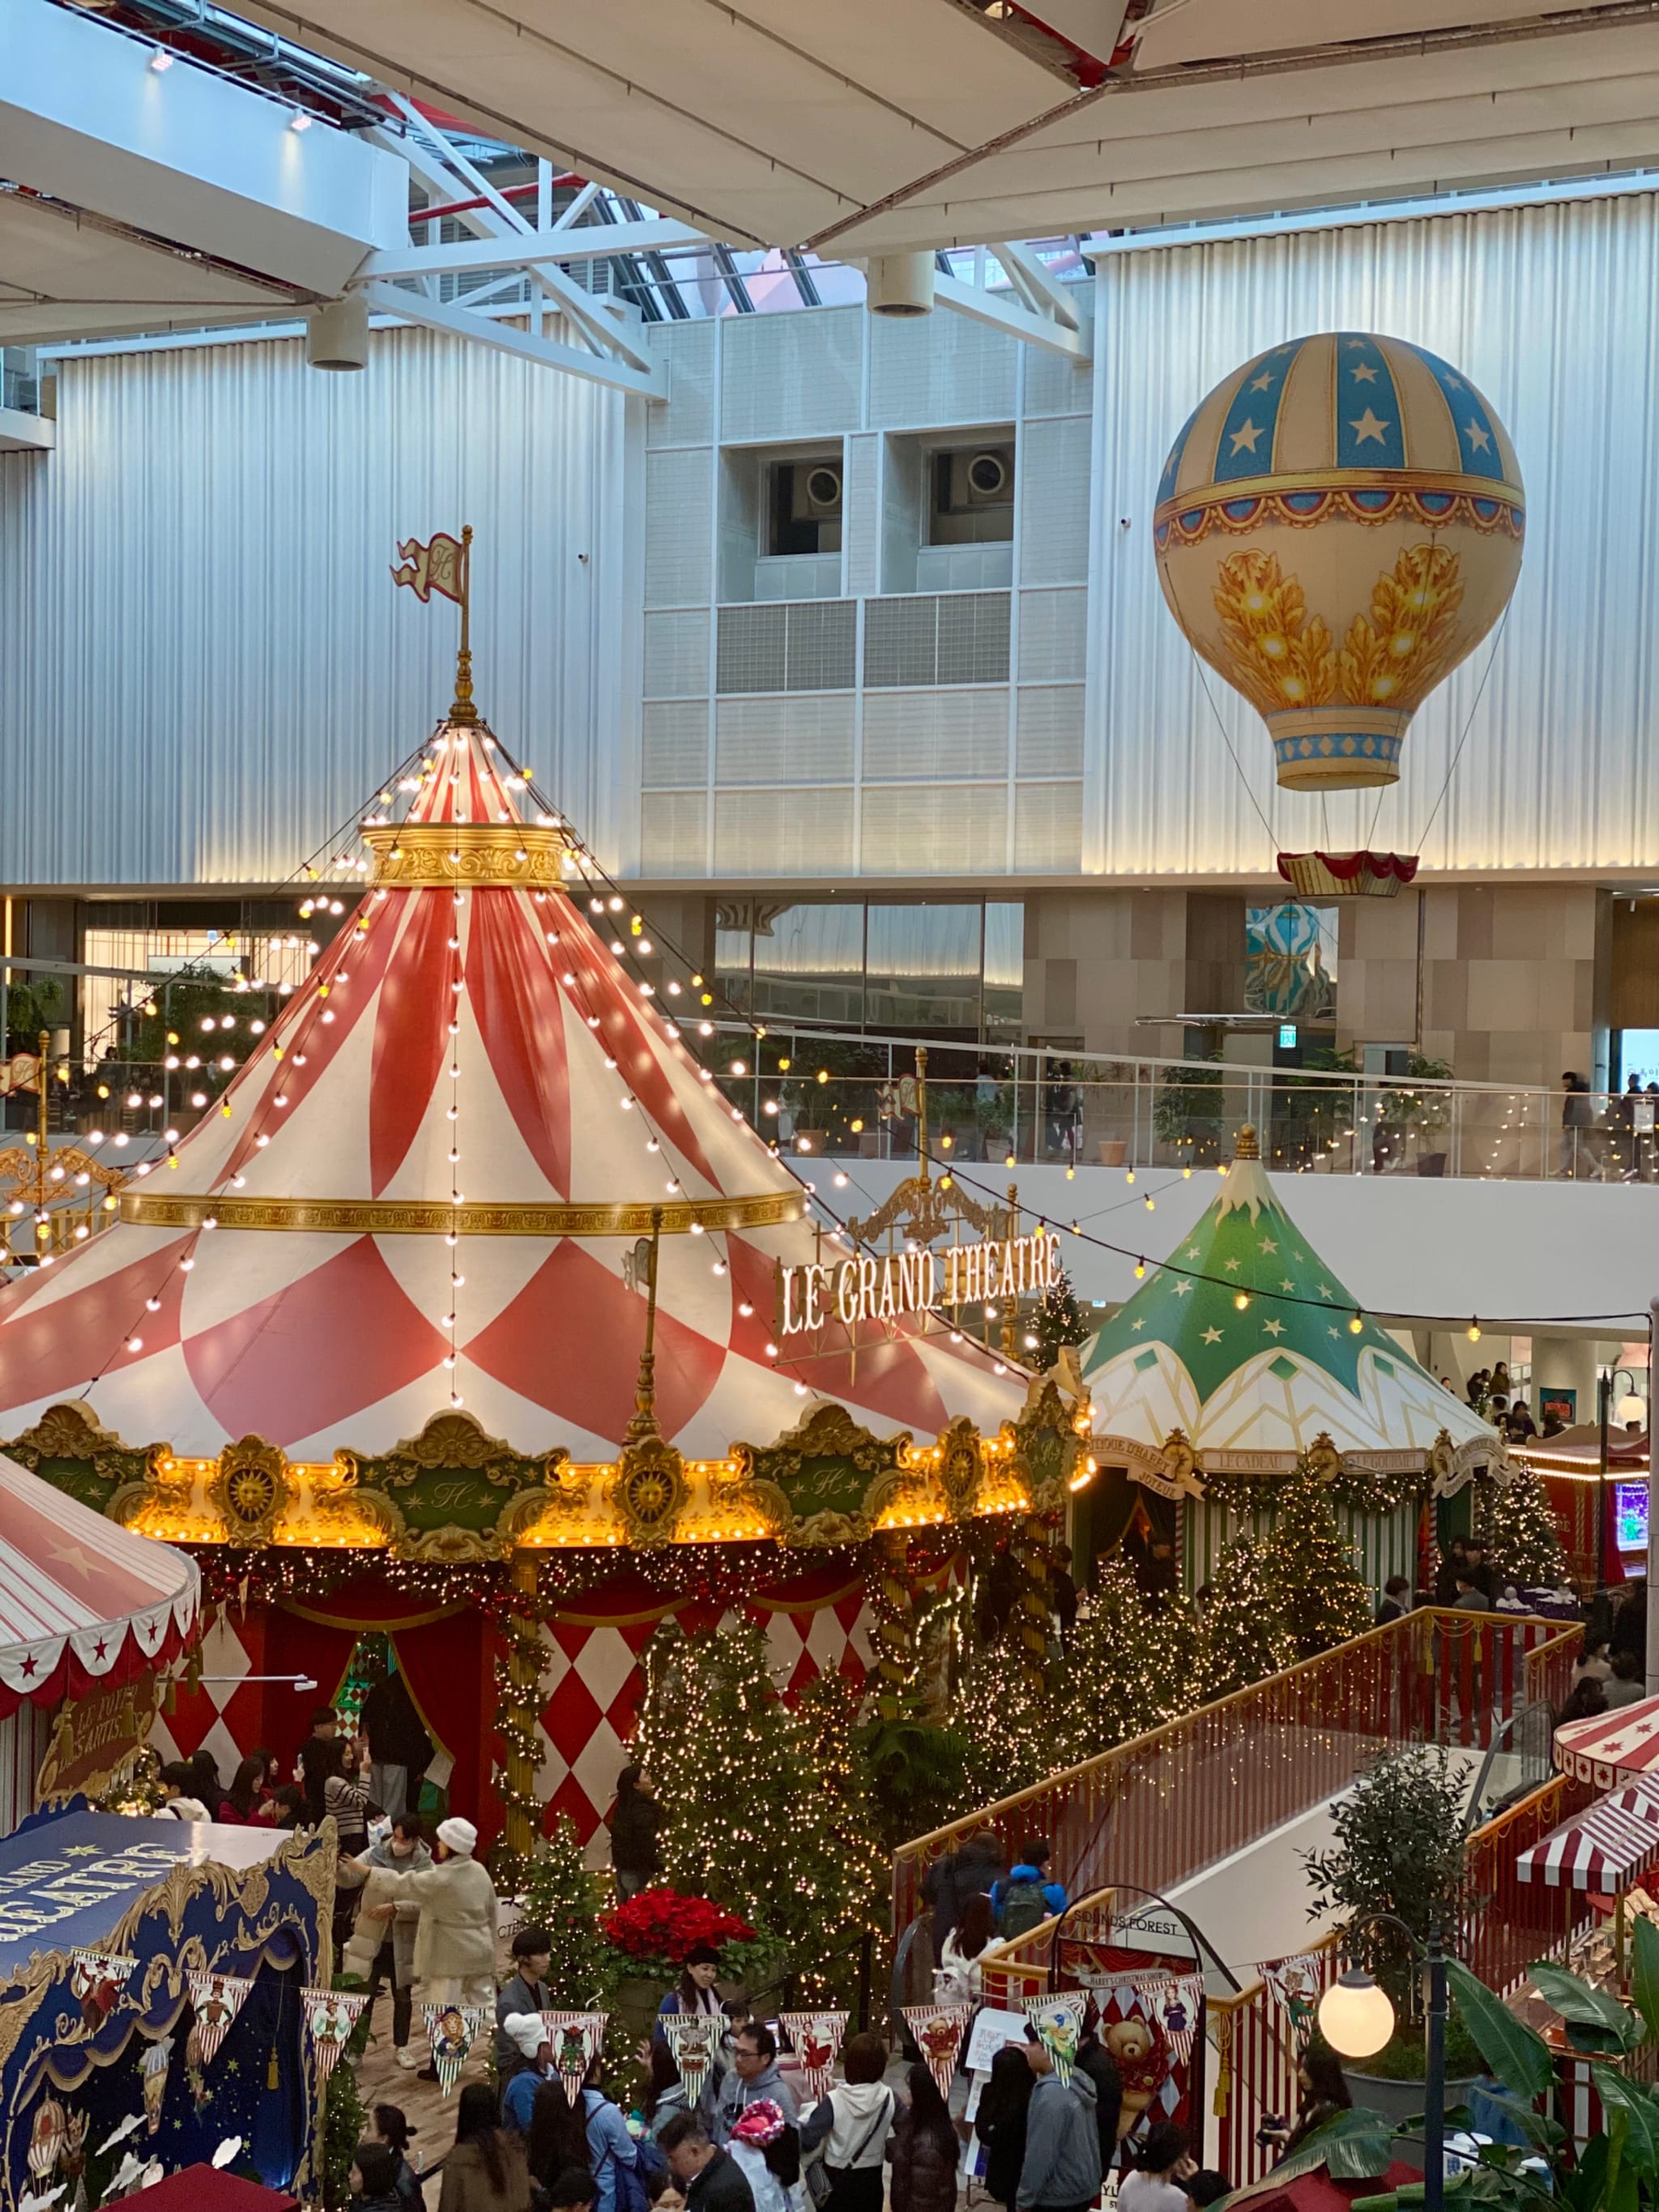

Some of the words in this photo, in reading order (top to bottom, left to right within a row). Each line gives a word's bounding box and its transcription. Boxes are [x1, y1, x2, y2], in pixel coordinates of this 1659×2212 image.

[782, 1264, 825, 1336] LE
[838, 1250, 935, 1324] GRAND
[946, 1233, 1060, 1306] THEATRE
[1126, 1440, 1171, 1473] D'HARRY
[1219, 1454, 1234, 1468] LE
[1235, 1454, 1282, 1468] CADEAU
[1138, 1471, 1177, 1498] JOYEUX
[1074, 1910, 1126, 1928] SOUNDS
[1129, 1918, 1178, 1936] FOREST
[1090, 1976, 1114, 1986] HARRY'S
[1114, 1974, 1146, 1985] CHRISTMAS
